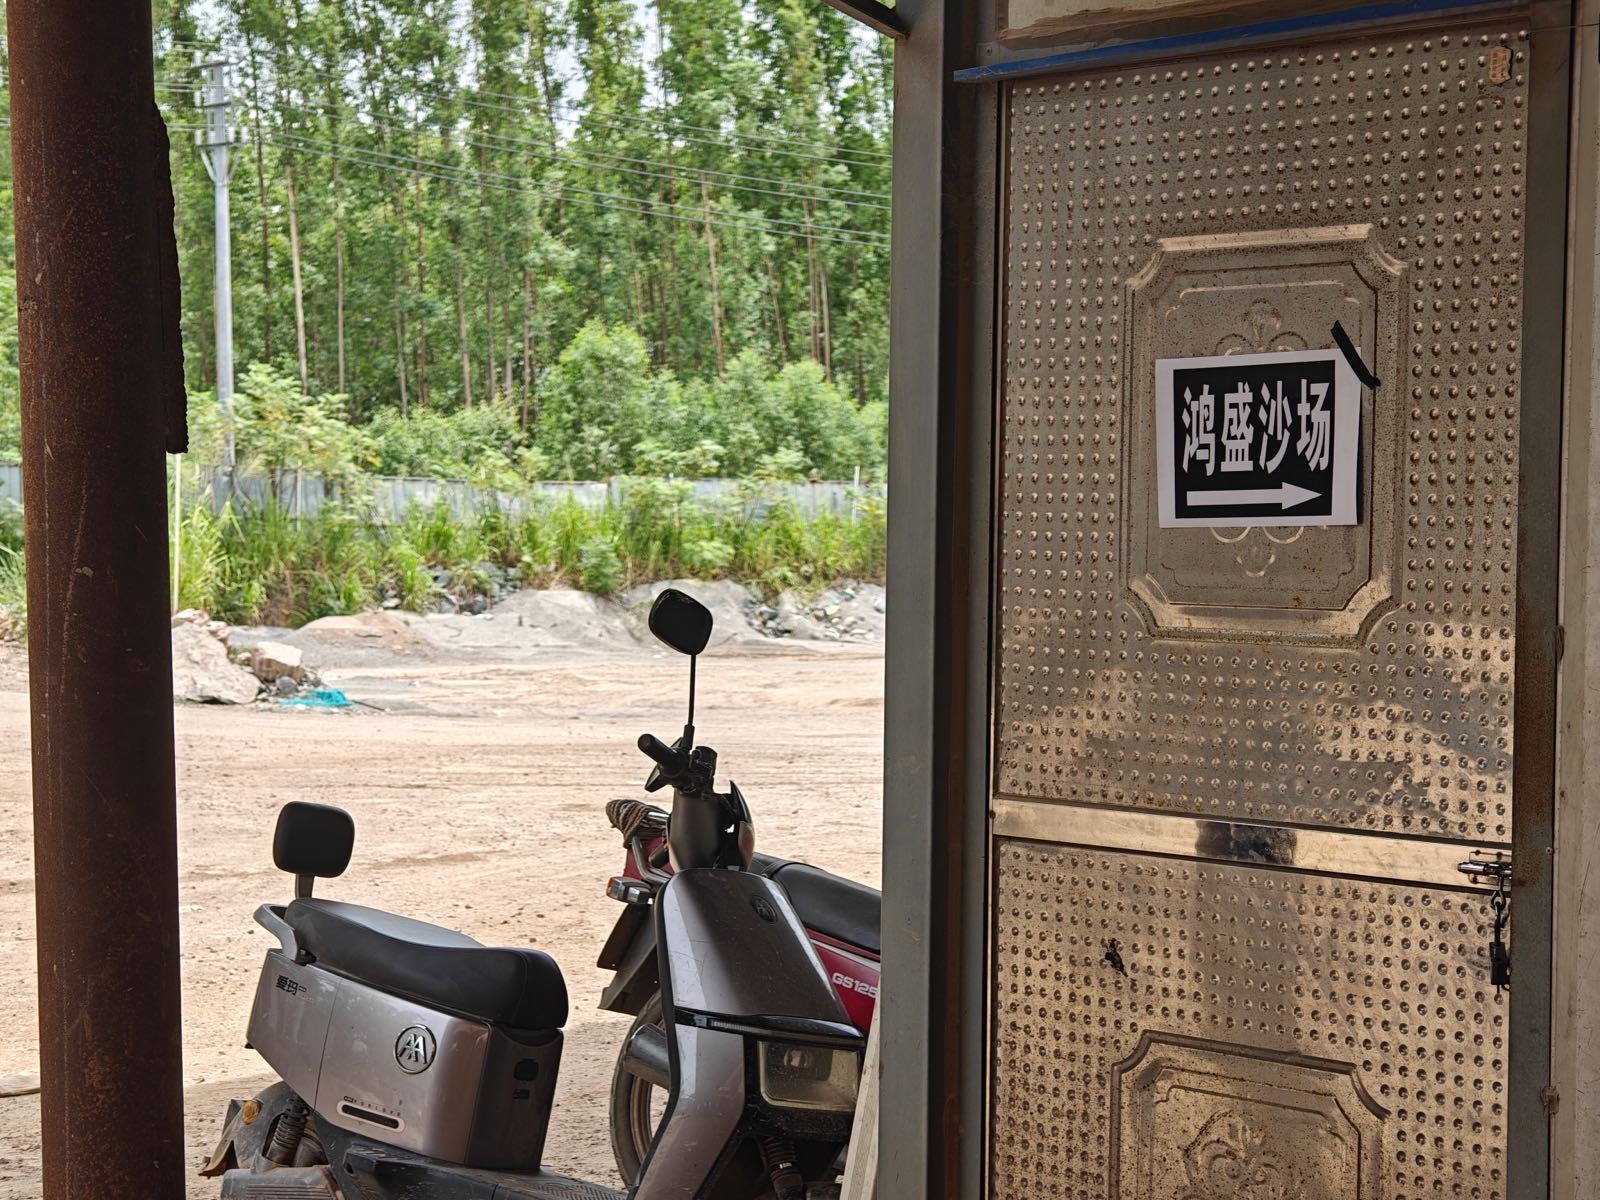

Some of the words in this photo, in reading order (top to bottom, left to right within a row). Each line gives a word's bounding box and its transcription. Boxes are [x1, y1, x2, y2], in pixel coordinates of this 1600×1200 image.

[1182, 379, 1331, 476] 鸿盛沙场
[276, 975, 299, 996] 爱玛
[832, 972, 878, 999] GS125
